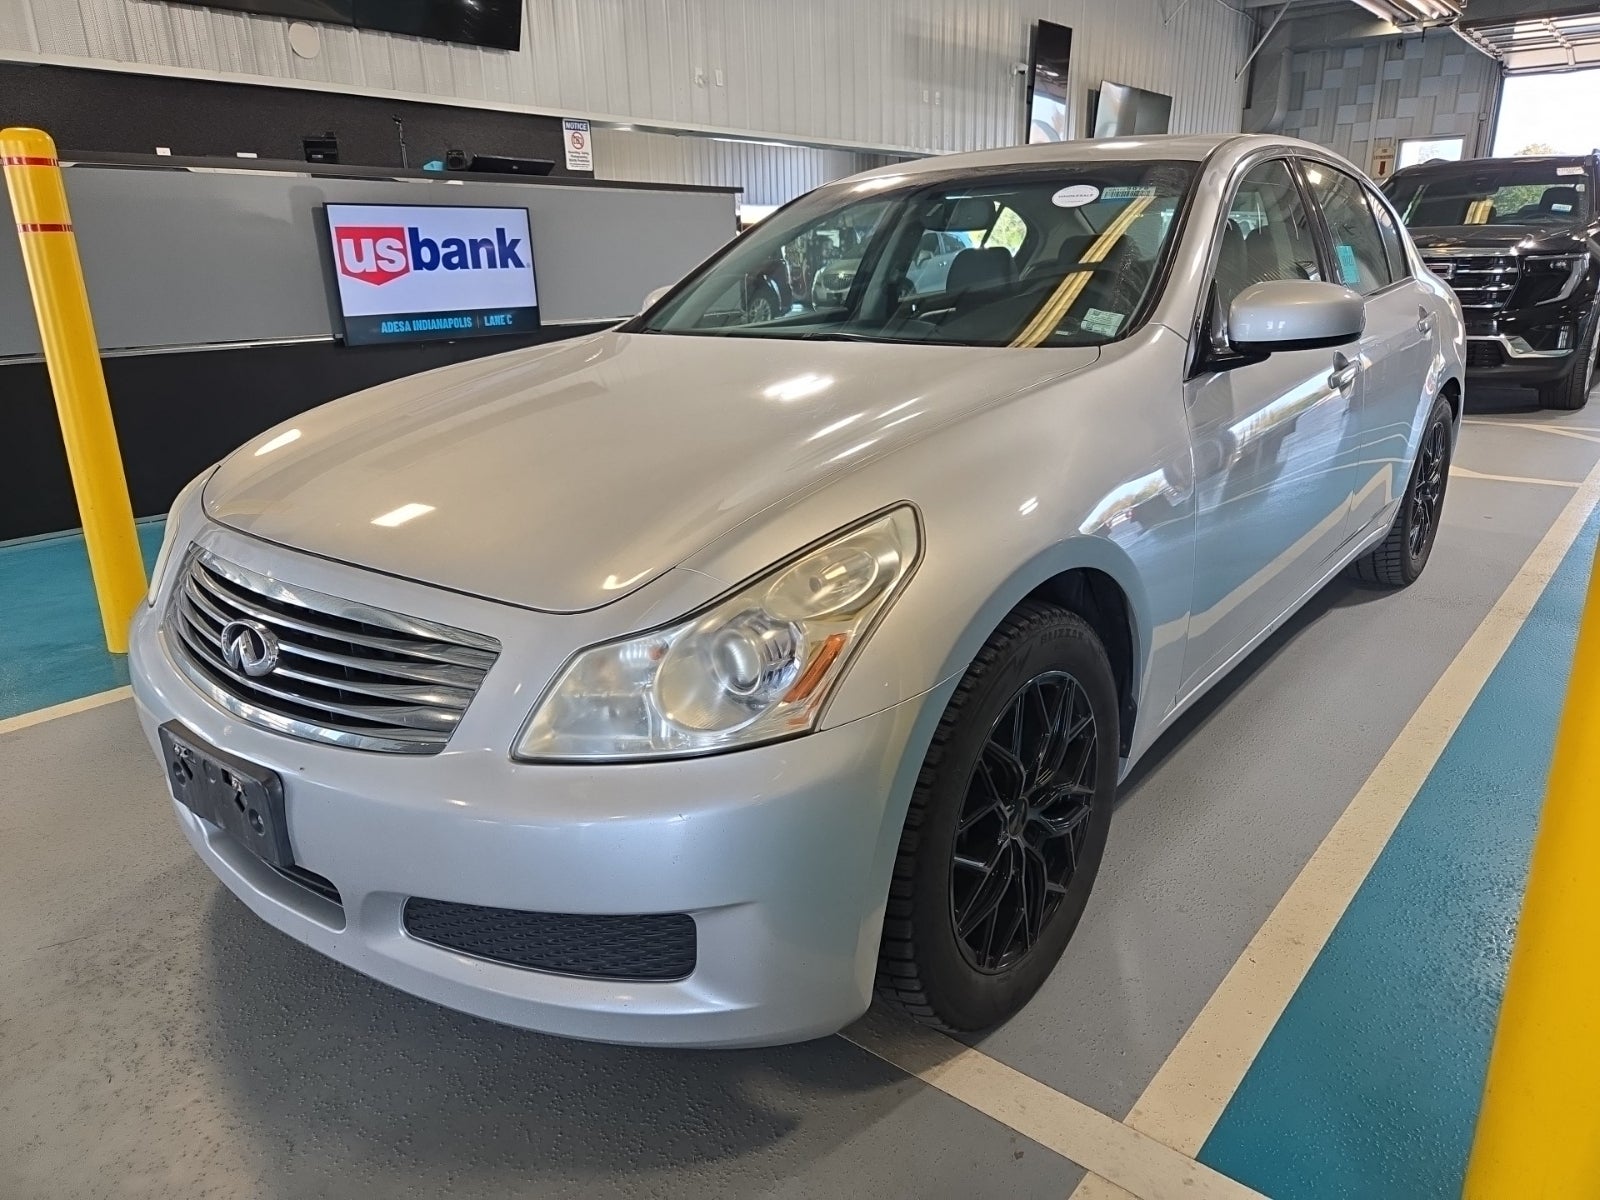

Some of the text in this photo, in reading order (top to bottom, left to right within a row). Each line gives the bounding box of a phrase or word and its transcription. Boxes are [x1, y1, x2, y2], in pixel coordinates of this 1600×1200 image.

[565, 122, 588, 131] NOTICE
[381, 314, 513, 333] ADESA INDIANAPOLIS LANE C
